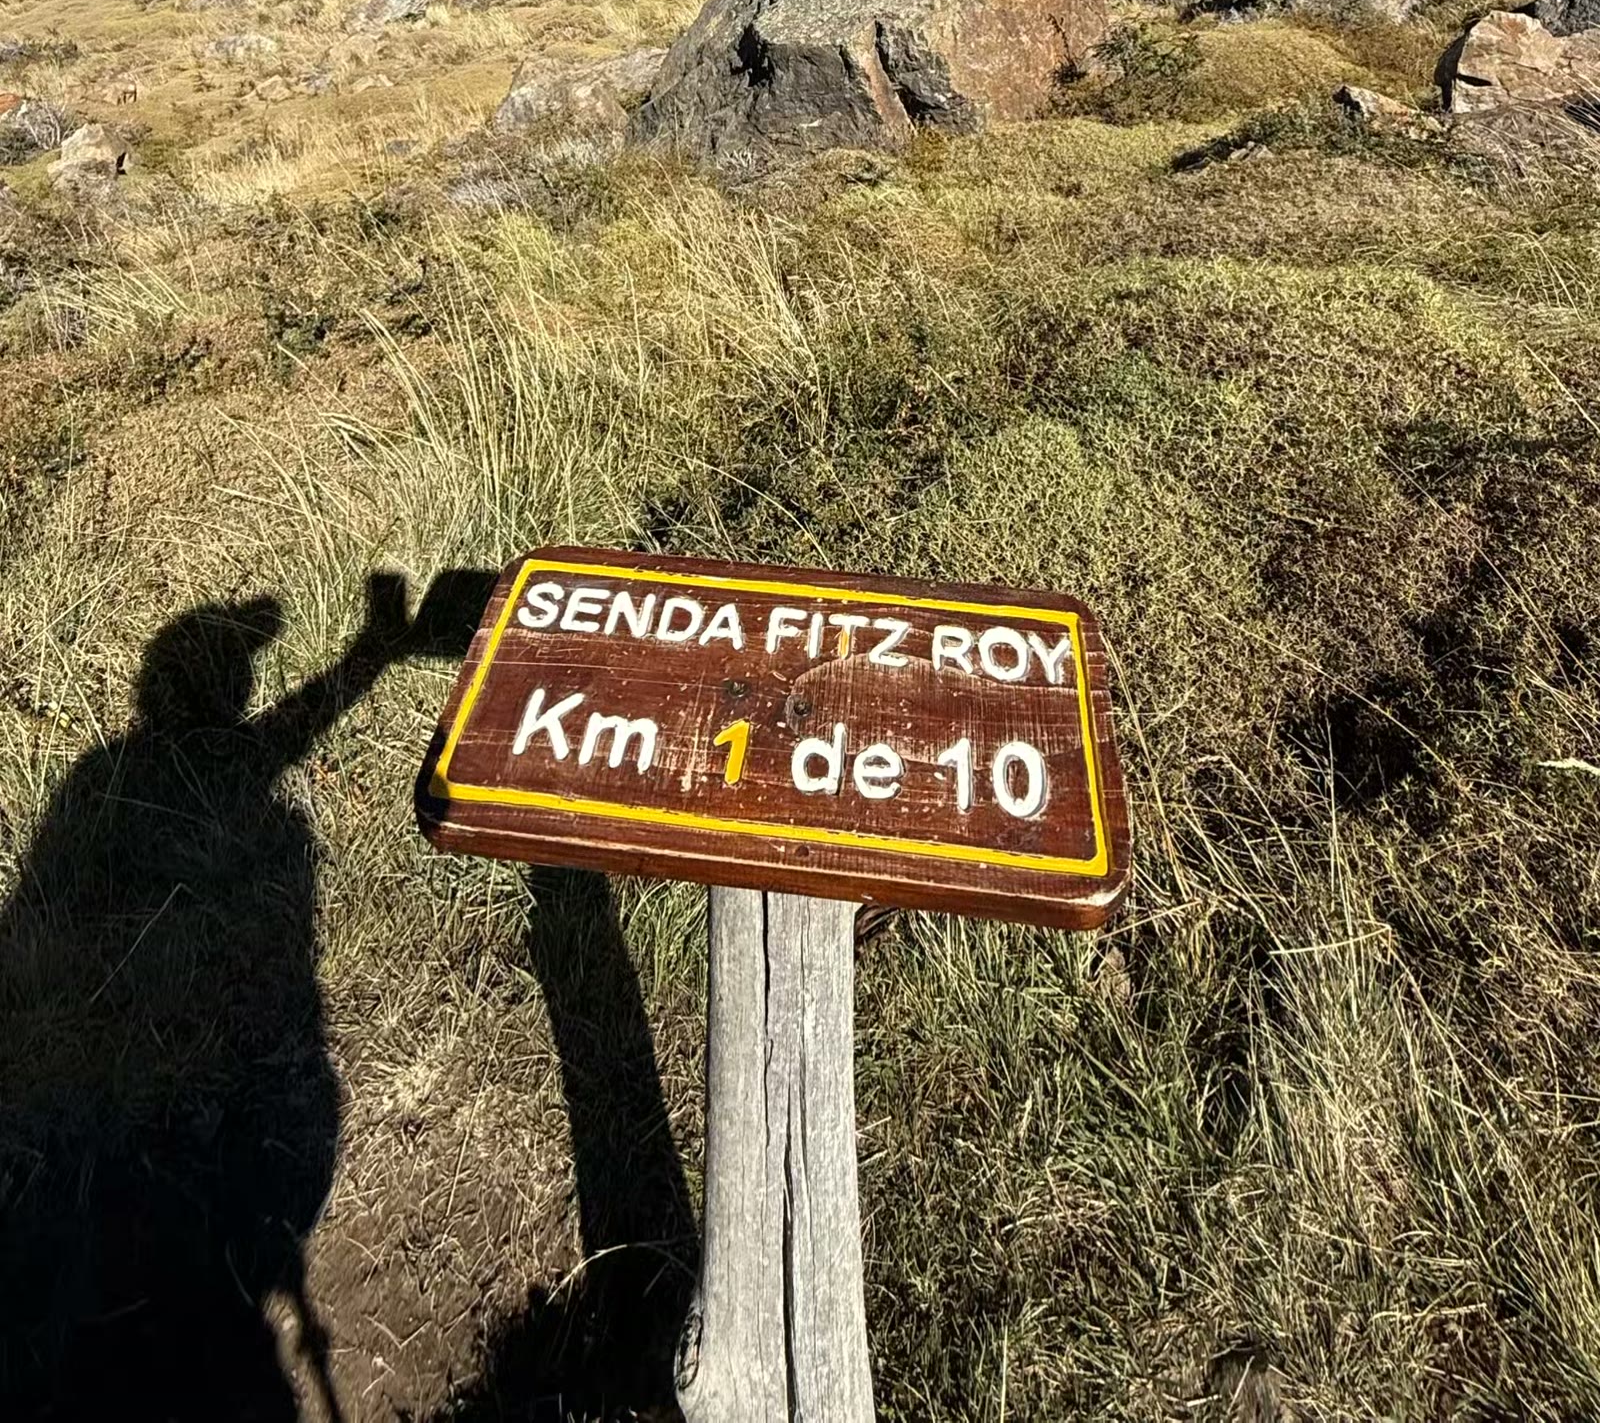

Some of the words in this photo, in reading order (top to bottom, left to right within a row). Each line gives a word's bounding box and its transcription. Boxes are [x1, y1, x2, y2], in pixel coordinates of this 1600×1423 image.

[517, 581, 743, 650] SENDA
[766, 606, 911, 667] FITZ
[932, 625, 1072, 684] ROY
[512, 688, 658, 773] Km
[714, 720, 752, 784] 1
[791, 723, 905, 800] de
[937, 737, 1048, 819] 10
